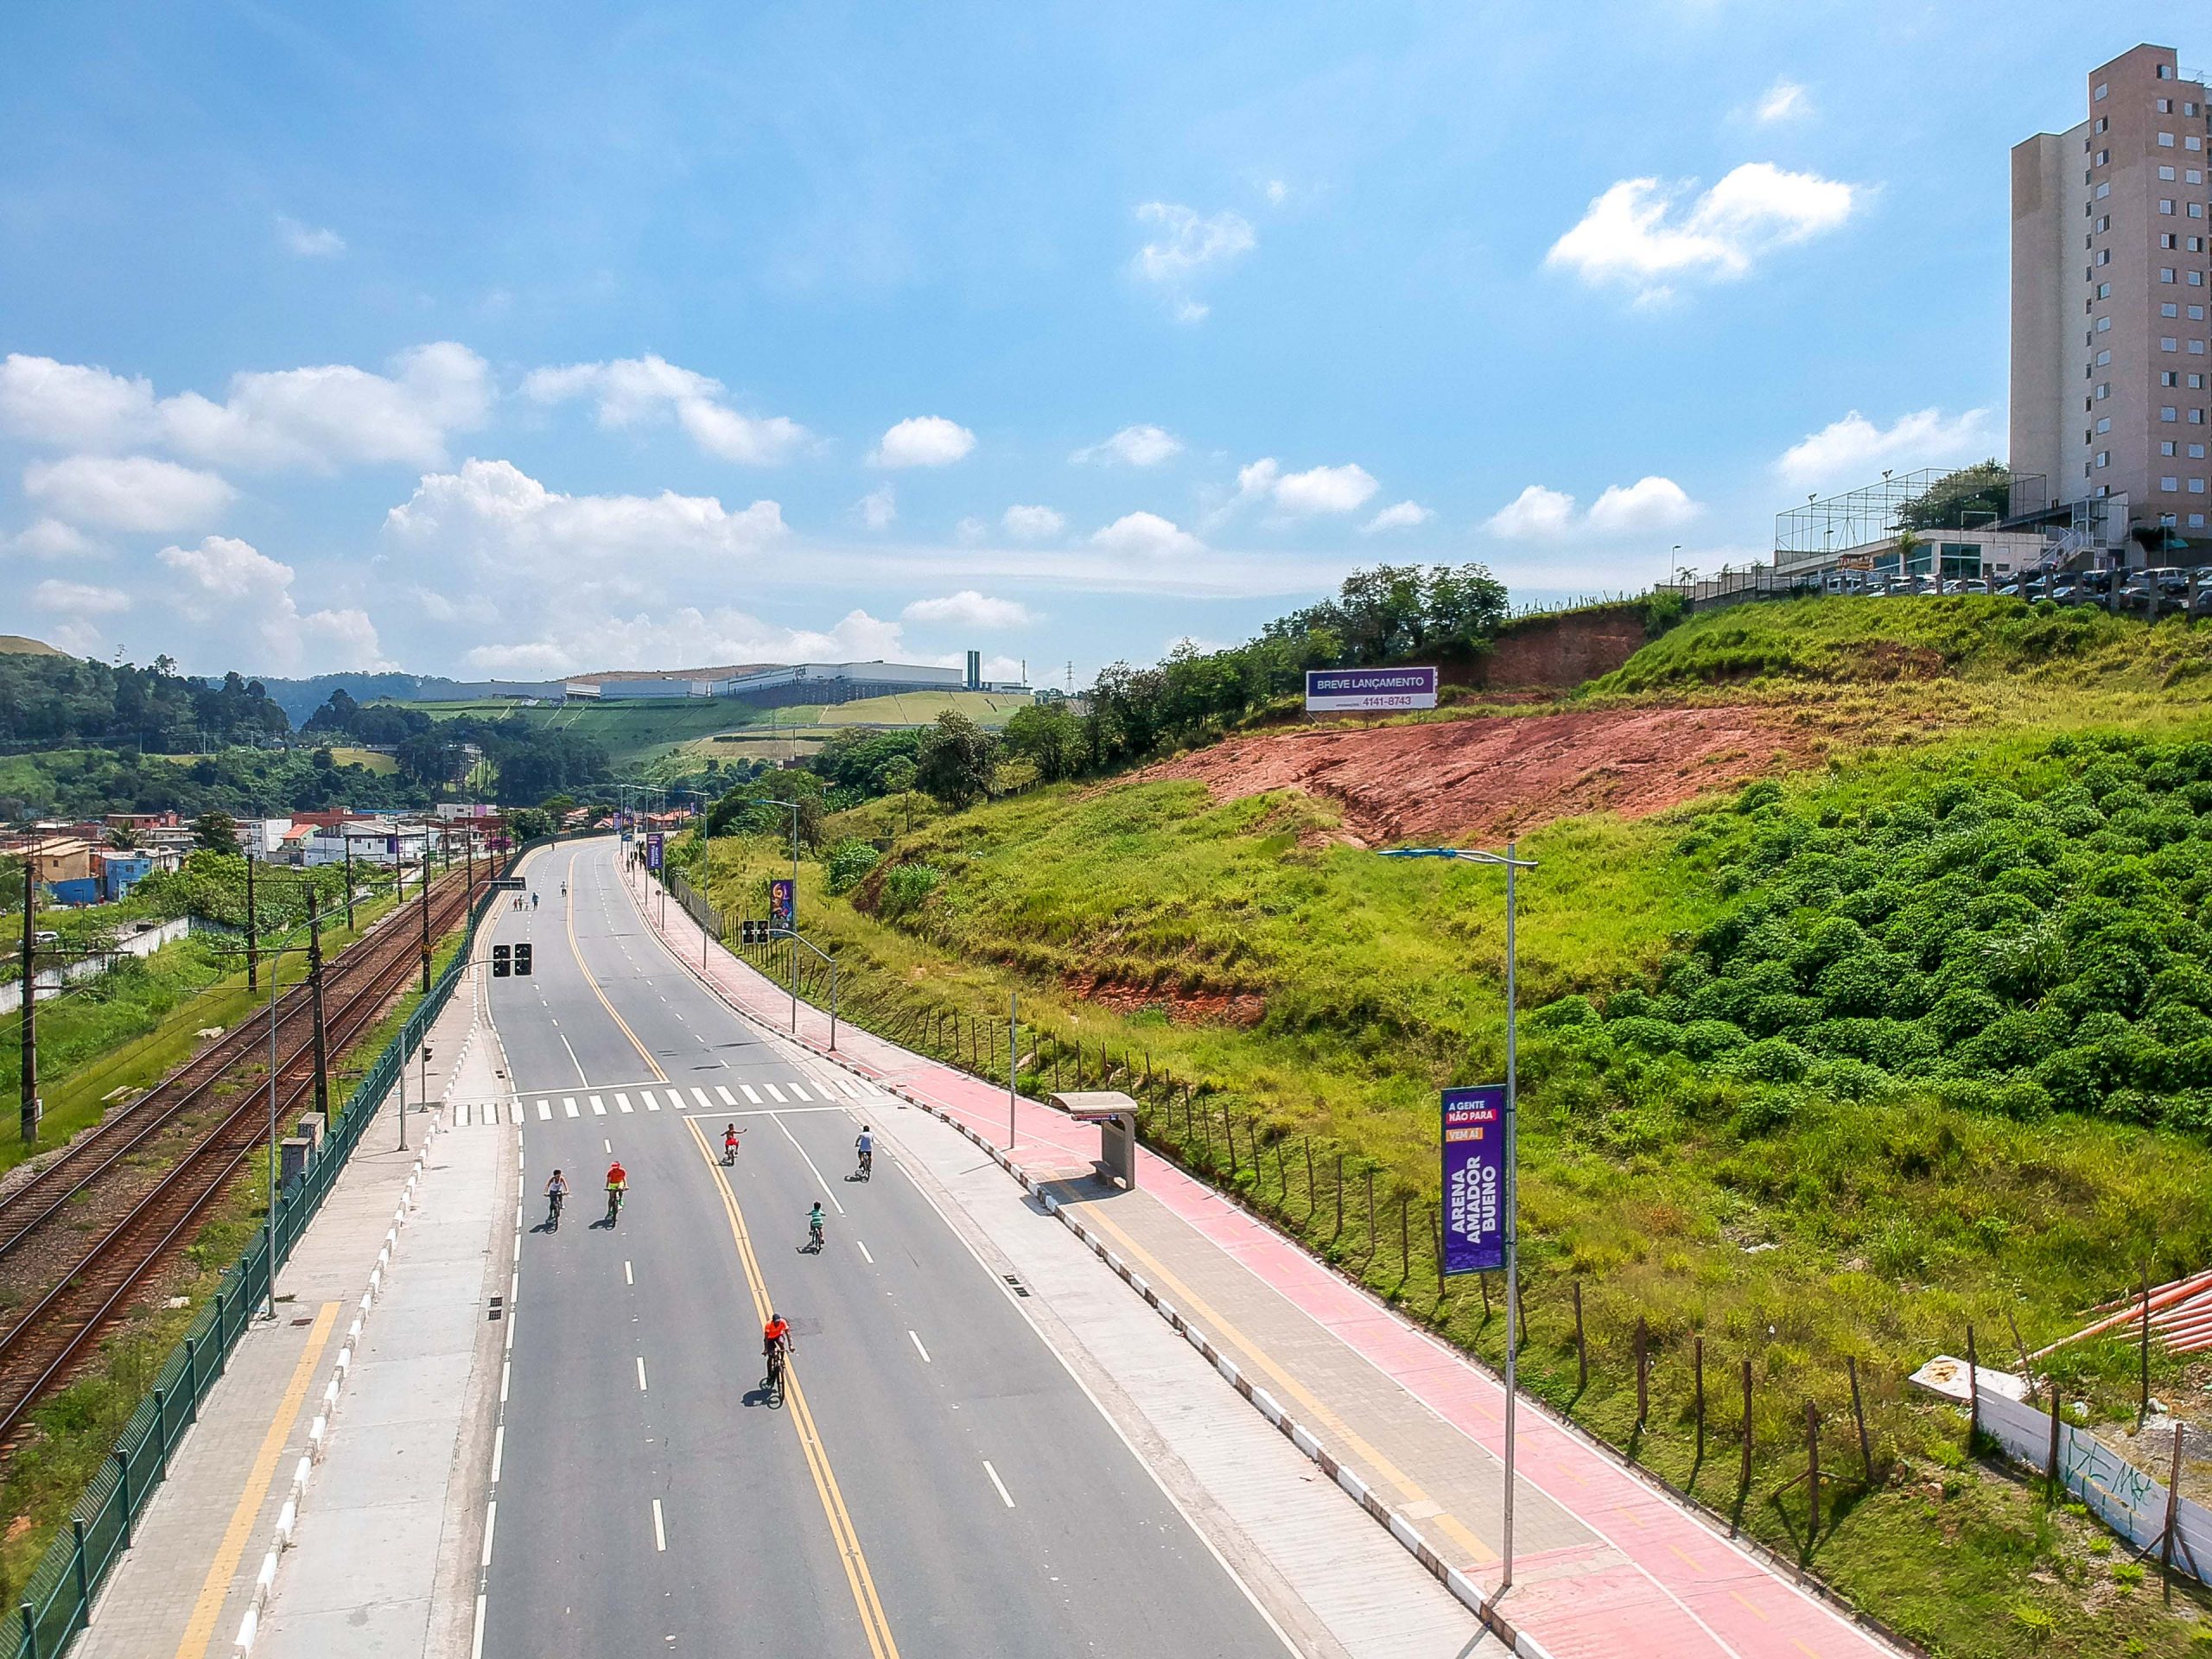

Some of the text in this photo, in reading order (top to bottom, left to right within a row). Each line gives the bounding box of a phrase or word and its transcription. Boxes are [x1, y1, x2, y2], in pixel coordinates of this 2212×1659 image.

[1317, 677, 1424, 690] BREVE LANÇAMENTO
[1363, 696, 1411, 707] 4141-8743
[1448, 1100, 1485, 1110] A GENTE
[1449, 1110, 1493, 1122] NÃO PARA
[1449, 1130, 1468, 1140] VEM
[1452, 1169, 1465, 1234] ARENA
[1466, 1155, 1481, 1244] AMADOR
[1482, 1166, 1497, 1232] BUENO
